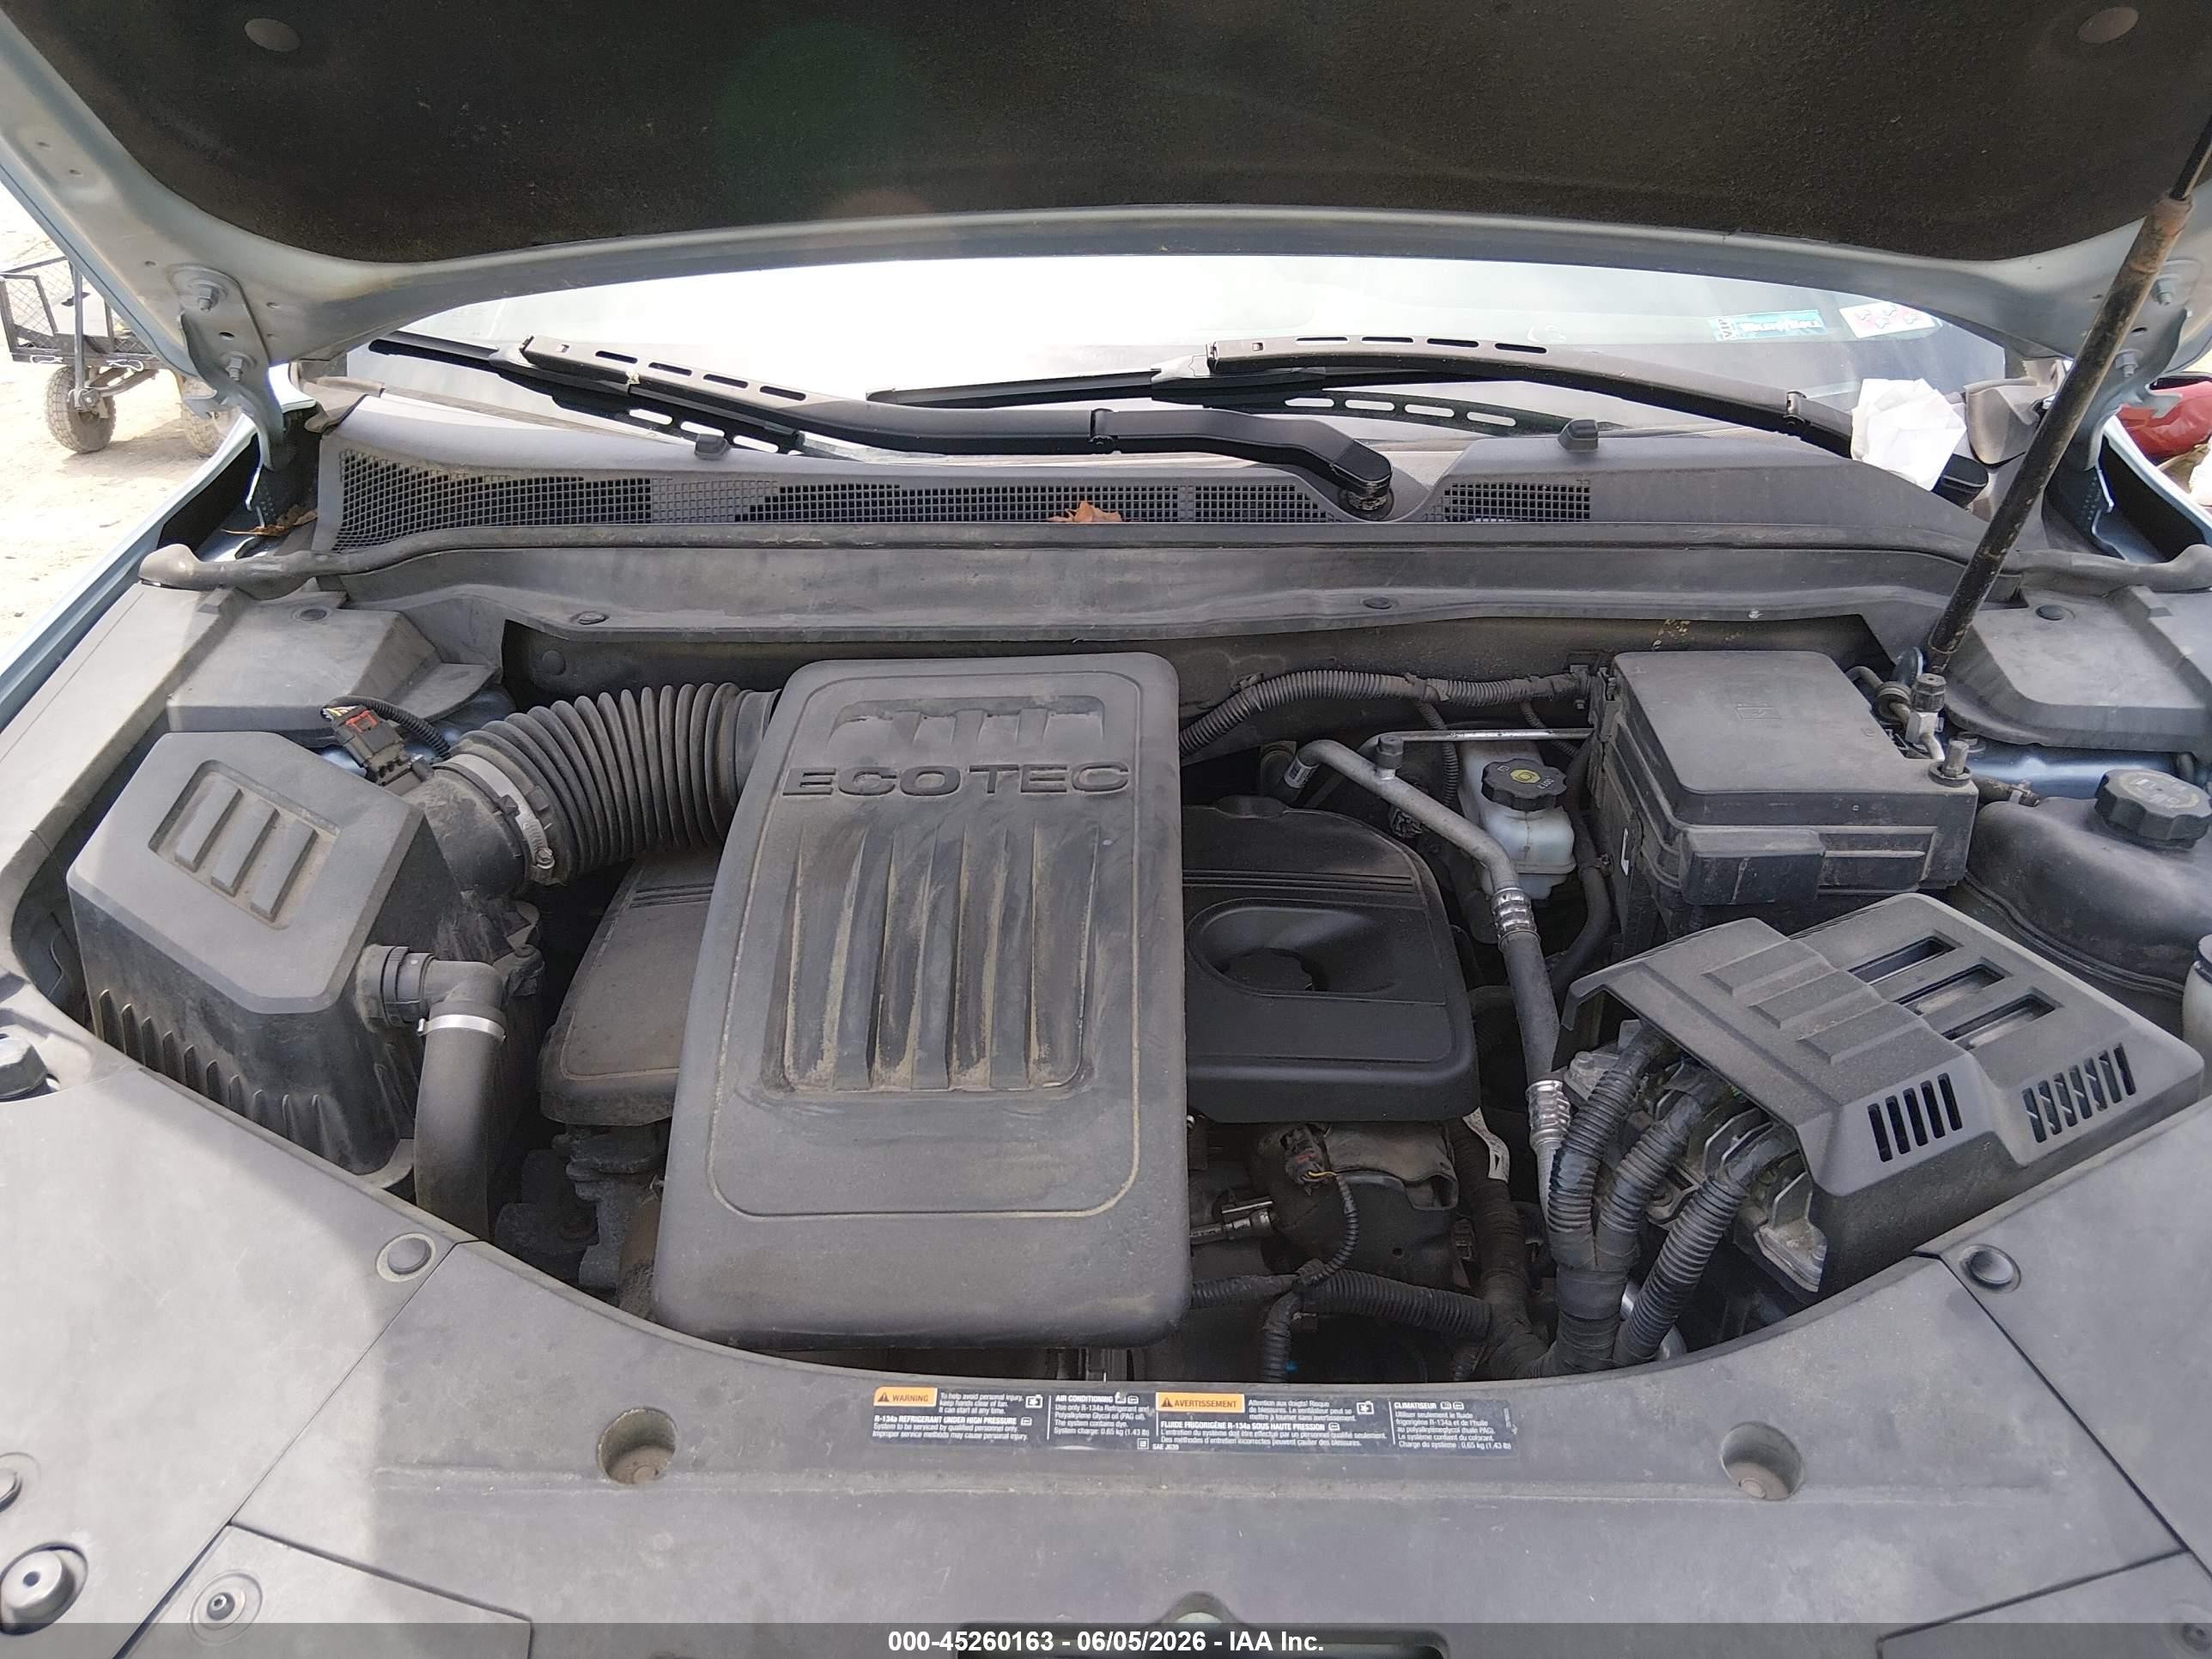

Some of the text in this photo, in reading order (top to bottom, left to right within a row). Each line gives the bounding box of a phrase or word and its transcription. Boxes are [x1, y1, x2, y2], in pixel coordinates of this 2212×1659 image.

[782, 761, 1129, 797] ECOTEC
[948, 1392, 962, 1401] help
[1067, 1395, 1114, 1403] CONDITIONING
[1067, 1404, 1080, 1413] only
[1309, 1400, 1329, 1408] Risque
[898, 1415, 943, 1424] REFRIGERANT
[1092, 1412, 1110, 1420] Glycol
[947, 1424, 974, 1432] qualified
[1160, 1420, 1325, 1431] FLUIDE FRIGORIGÈNE R-134a SOUS HAUTE PRESSION
[872, 1431, 900, 1439] Improper
[1054, 1426, 1077, 1435] System
[1077, 1427, 1099, 1437] charge:
[1115, 1428, 1124, 1437] kg
[1398, 1440, 1421, 1449] Charge
[1476, 1442, 1486, 1450] kg
[1503, 1442, 1511, 1450] lb)
